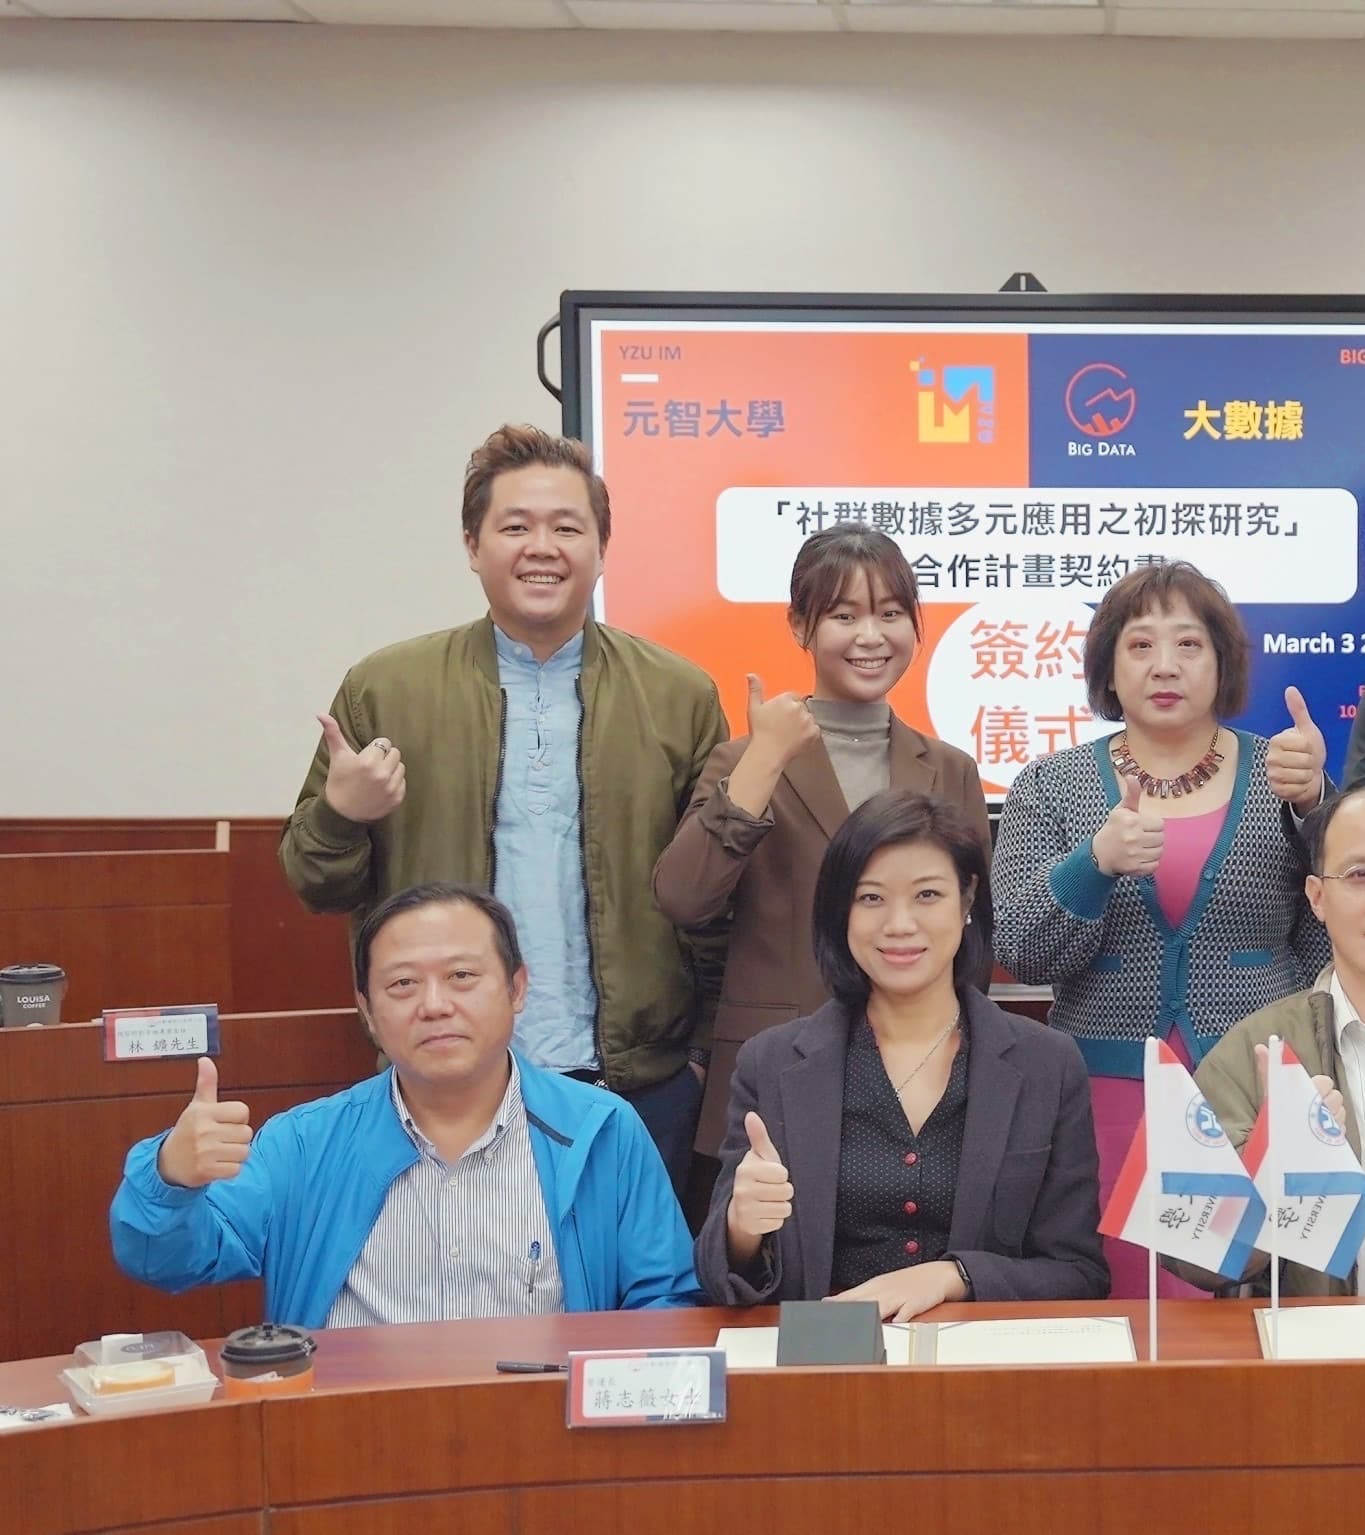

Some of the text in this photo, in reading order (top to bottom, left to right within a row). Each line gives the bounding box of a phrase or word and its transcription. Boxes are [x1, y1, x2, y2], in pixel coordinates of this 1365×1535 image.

[619, 345, 682, 361] YZU IM
[623, 399, 786, 439] 元智大學
[1183, 400, 1304, 441] 大數據
[970, 619, 1089, 680] 簽約
[1263, 632, 1335, 654] March
[1341, 632, 1355, 654] 3
[970, 704, 1095, 765] 儀式
[17, 995, 50, 1004] LOUISA
